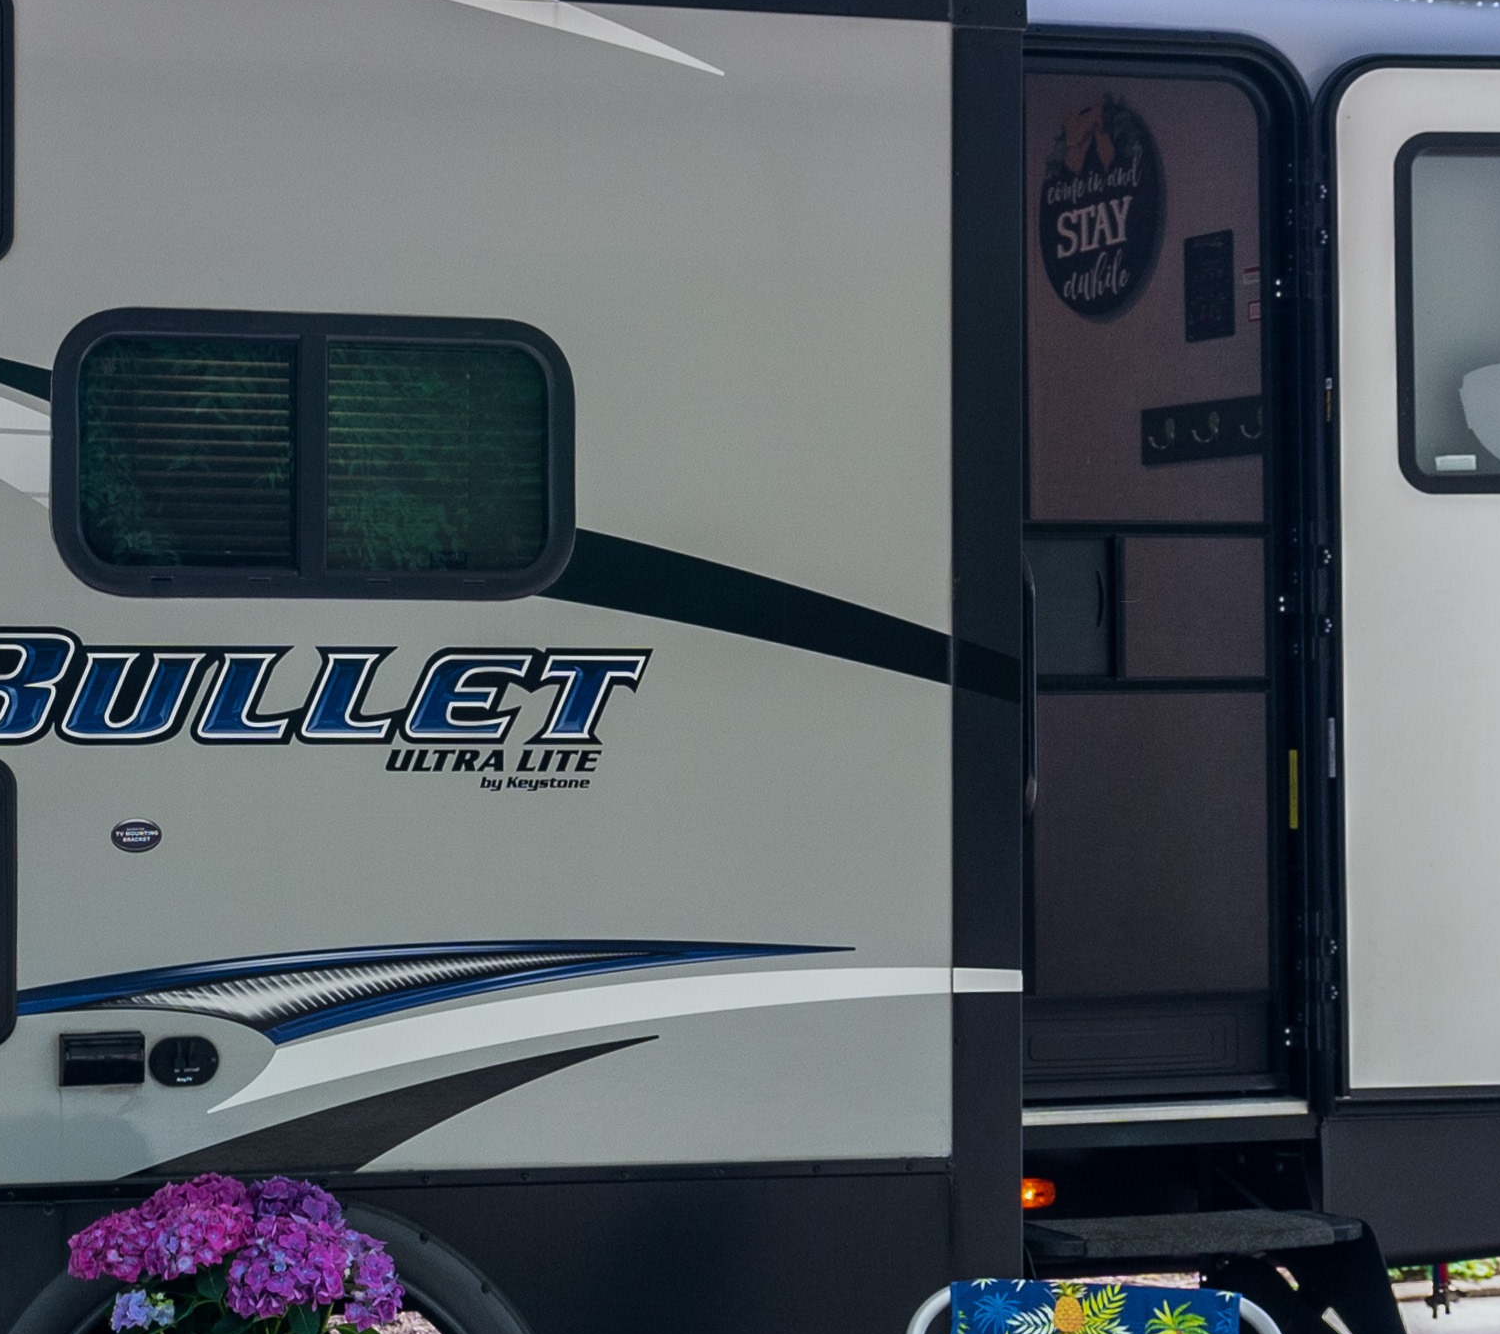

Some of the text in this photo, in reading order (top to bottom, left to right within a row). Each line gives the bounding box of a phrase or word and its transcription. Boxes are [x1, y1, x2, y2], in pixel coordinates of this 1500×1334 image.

[1047, 144, 1143, 205] come in and
[1056, 195, 1133, 259] STAY
[385, 749, 603, 772] ULTRA LITE
[480, 776, 591, 792] by Keystone
